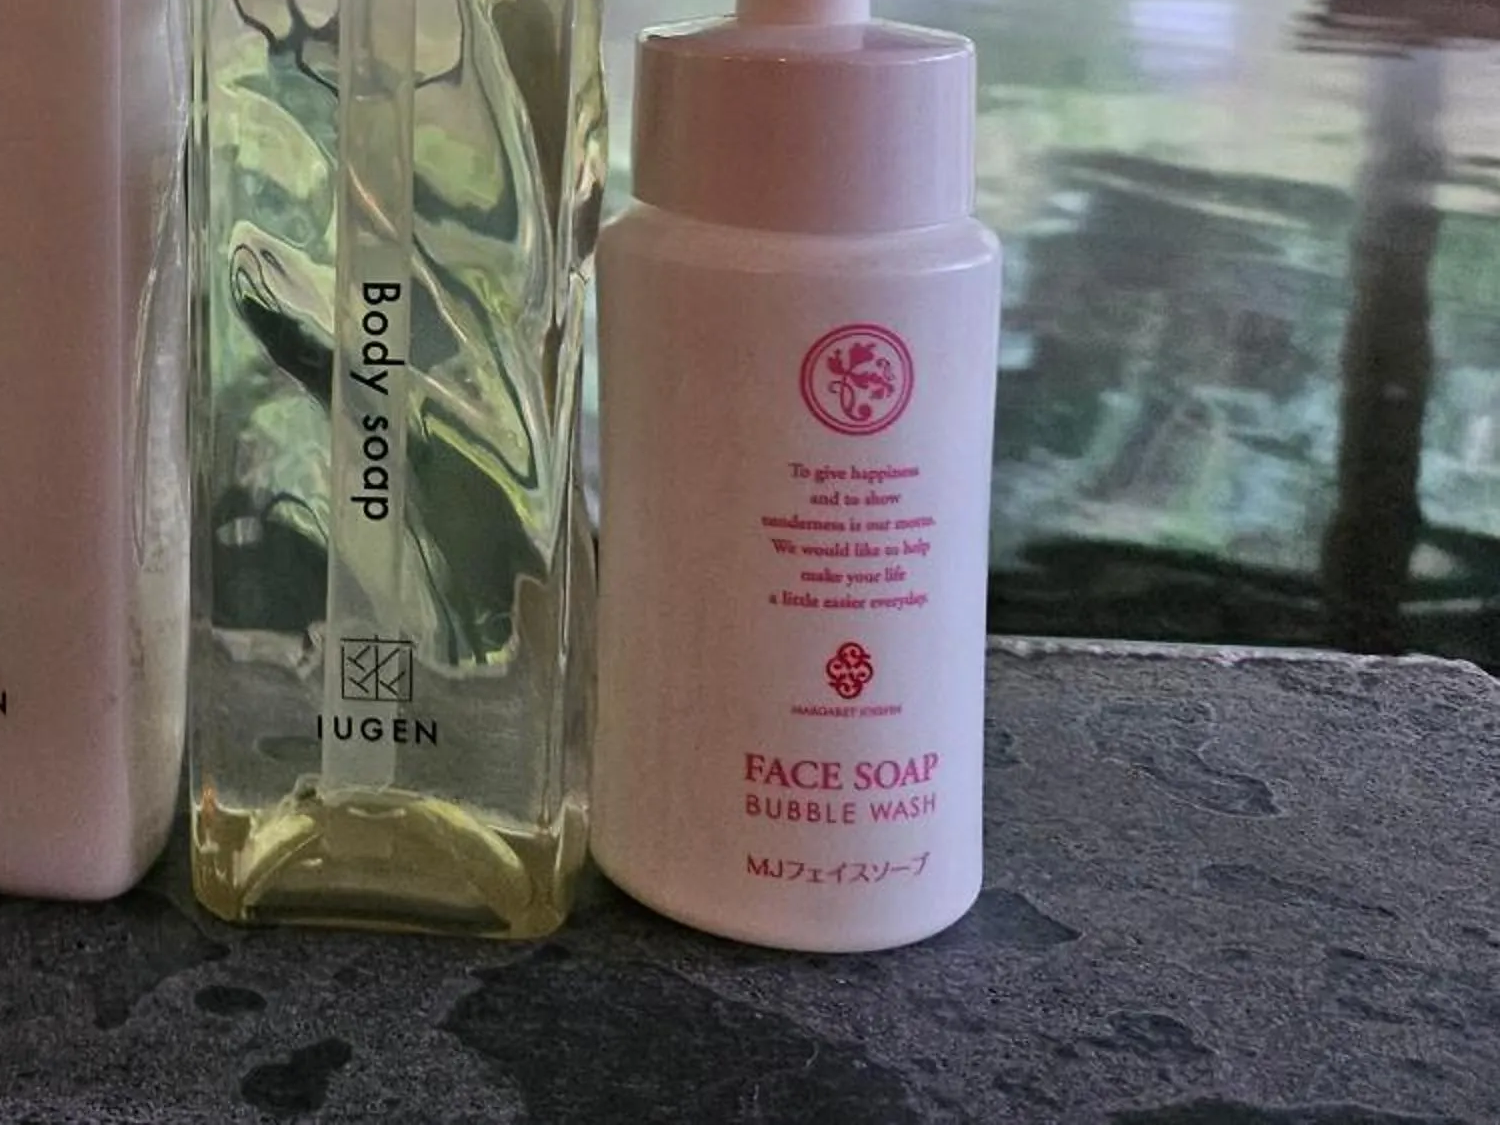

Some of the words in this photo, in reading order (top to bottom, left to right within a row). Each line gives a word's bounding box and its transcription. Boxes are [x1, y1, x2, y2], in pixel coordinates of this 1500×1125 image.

[350, 282, 405, 395] Body
[350, 414, 389, 521] soap
[810, 491, 840, 506] and
[865, 491, 902, 506] show
[802, 543, 849, 557] would
[854, 542, 881, 557] like
[317, 715, 438, 746] IUGEN
[745, 752, 844, 791] FACE
[853, 752, 940, 791] SOAP
[746, 794, 856, 824] BUBBLE
[870, 792, 937, 824] WASH
